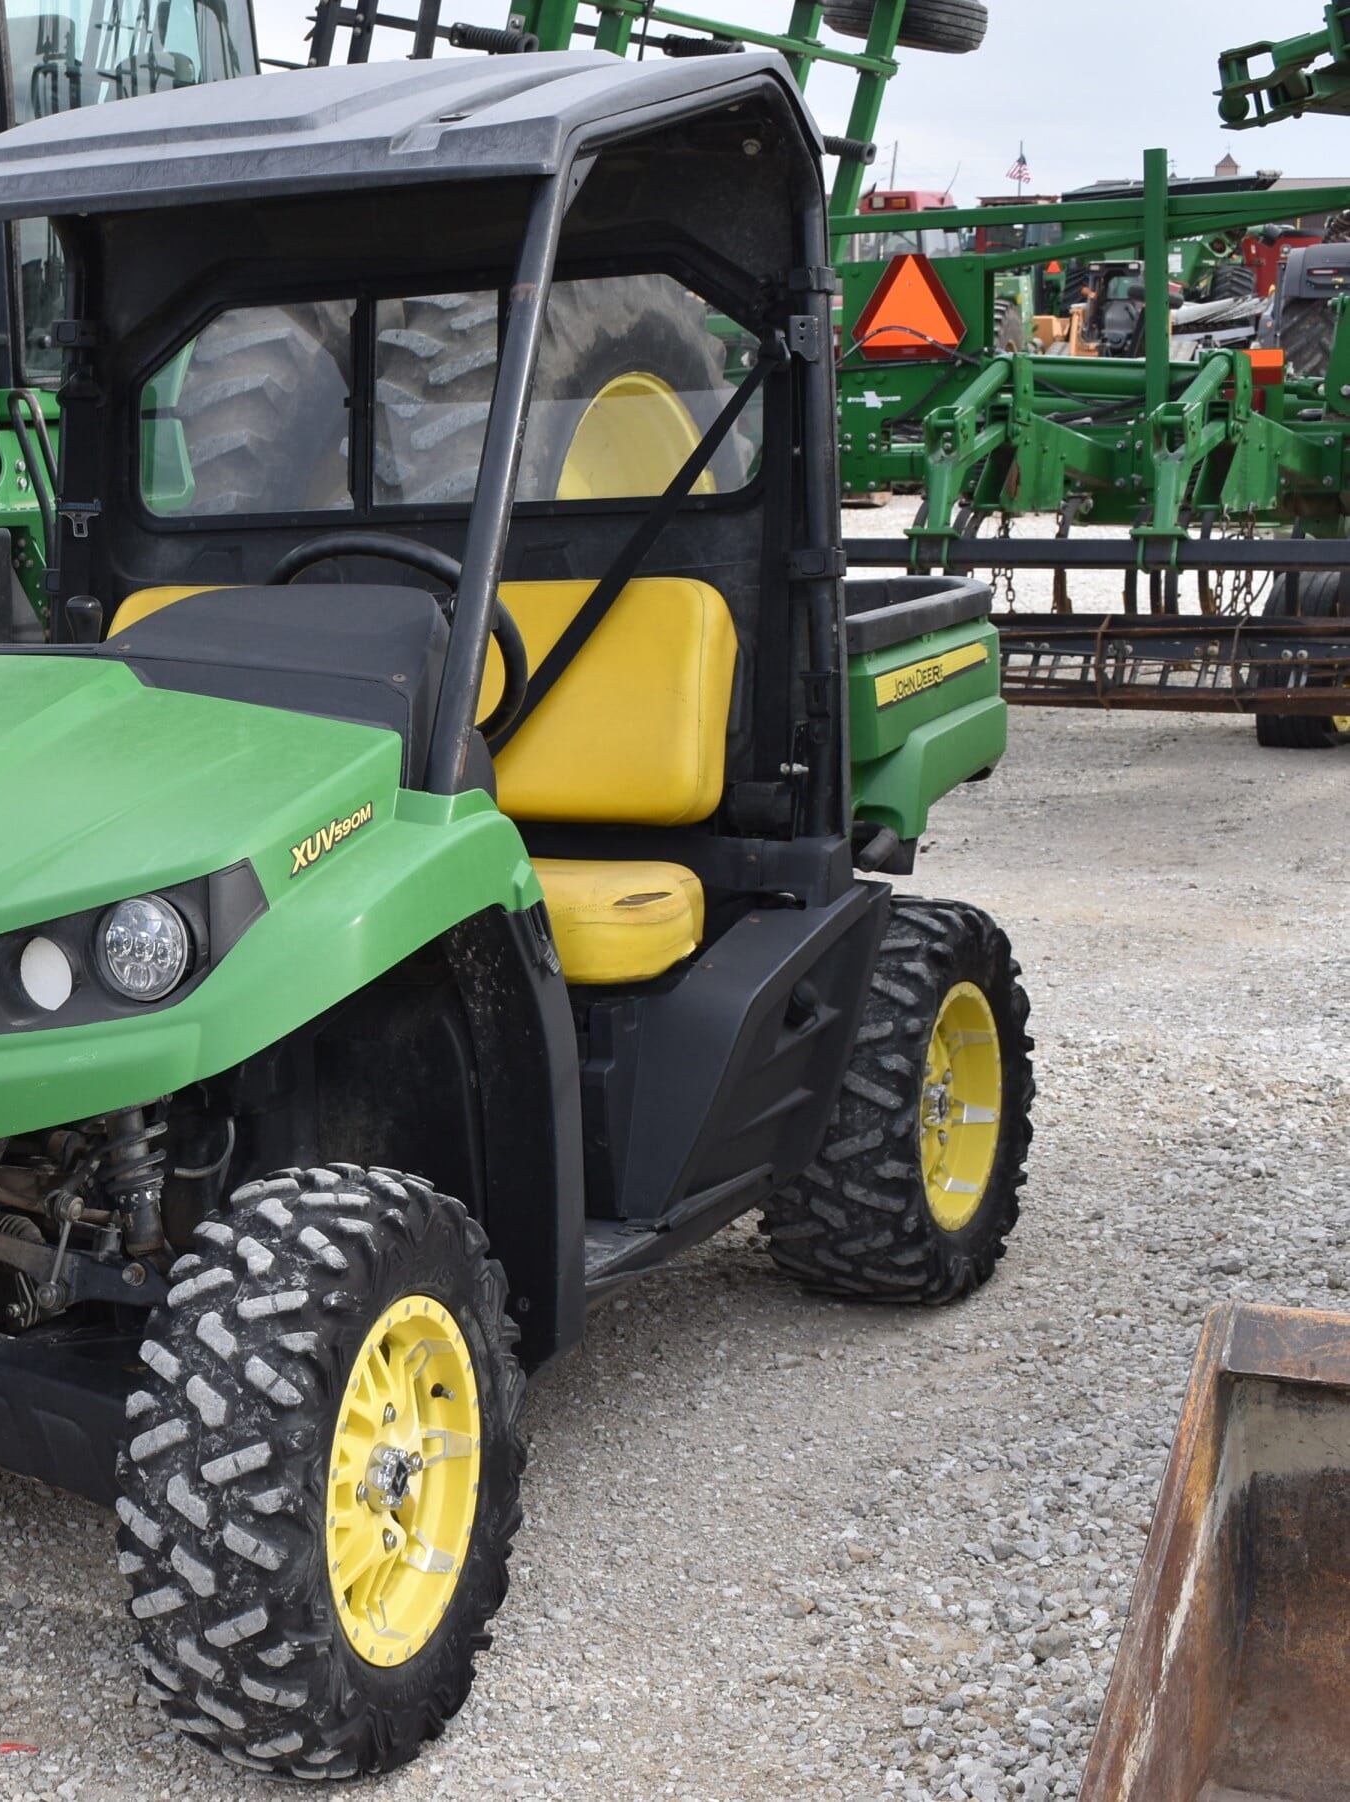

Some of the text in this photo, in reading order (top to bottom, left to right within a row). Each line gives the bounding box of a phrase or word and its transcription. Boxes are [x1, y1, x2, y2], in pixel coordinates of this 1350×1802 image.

[892, 663, 945, 701] JOHN DEERE
[290, 801, 373, 879] XUV590M
